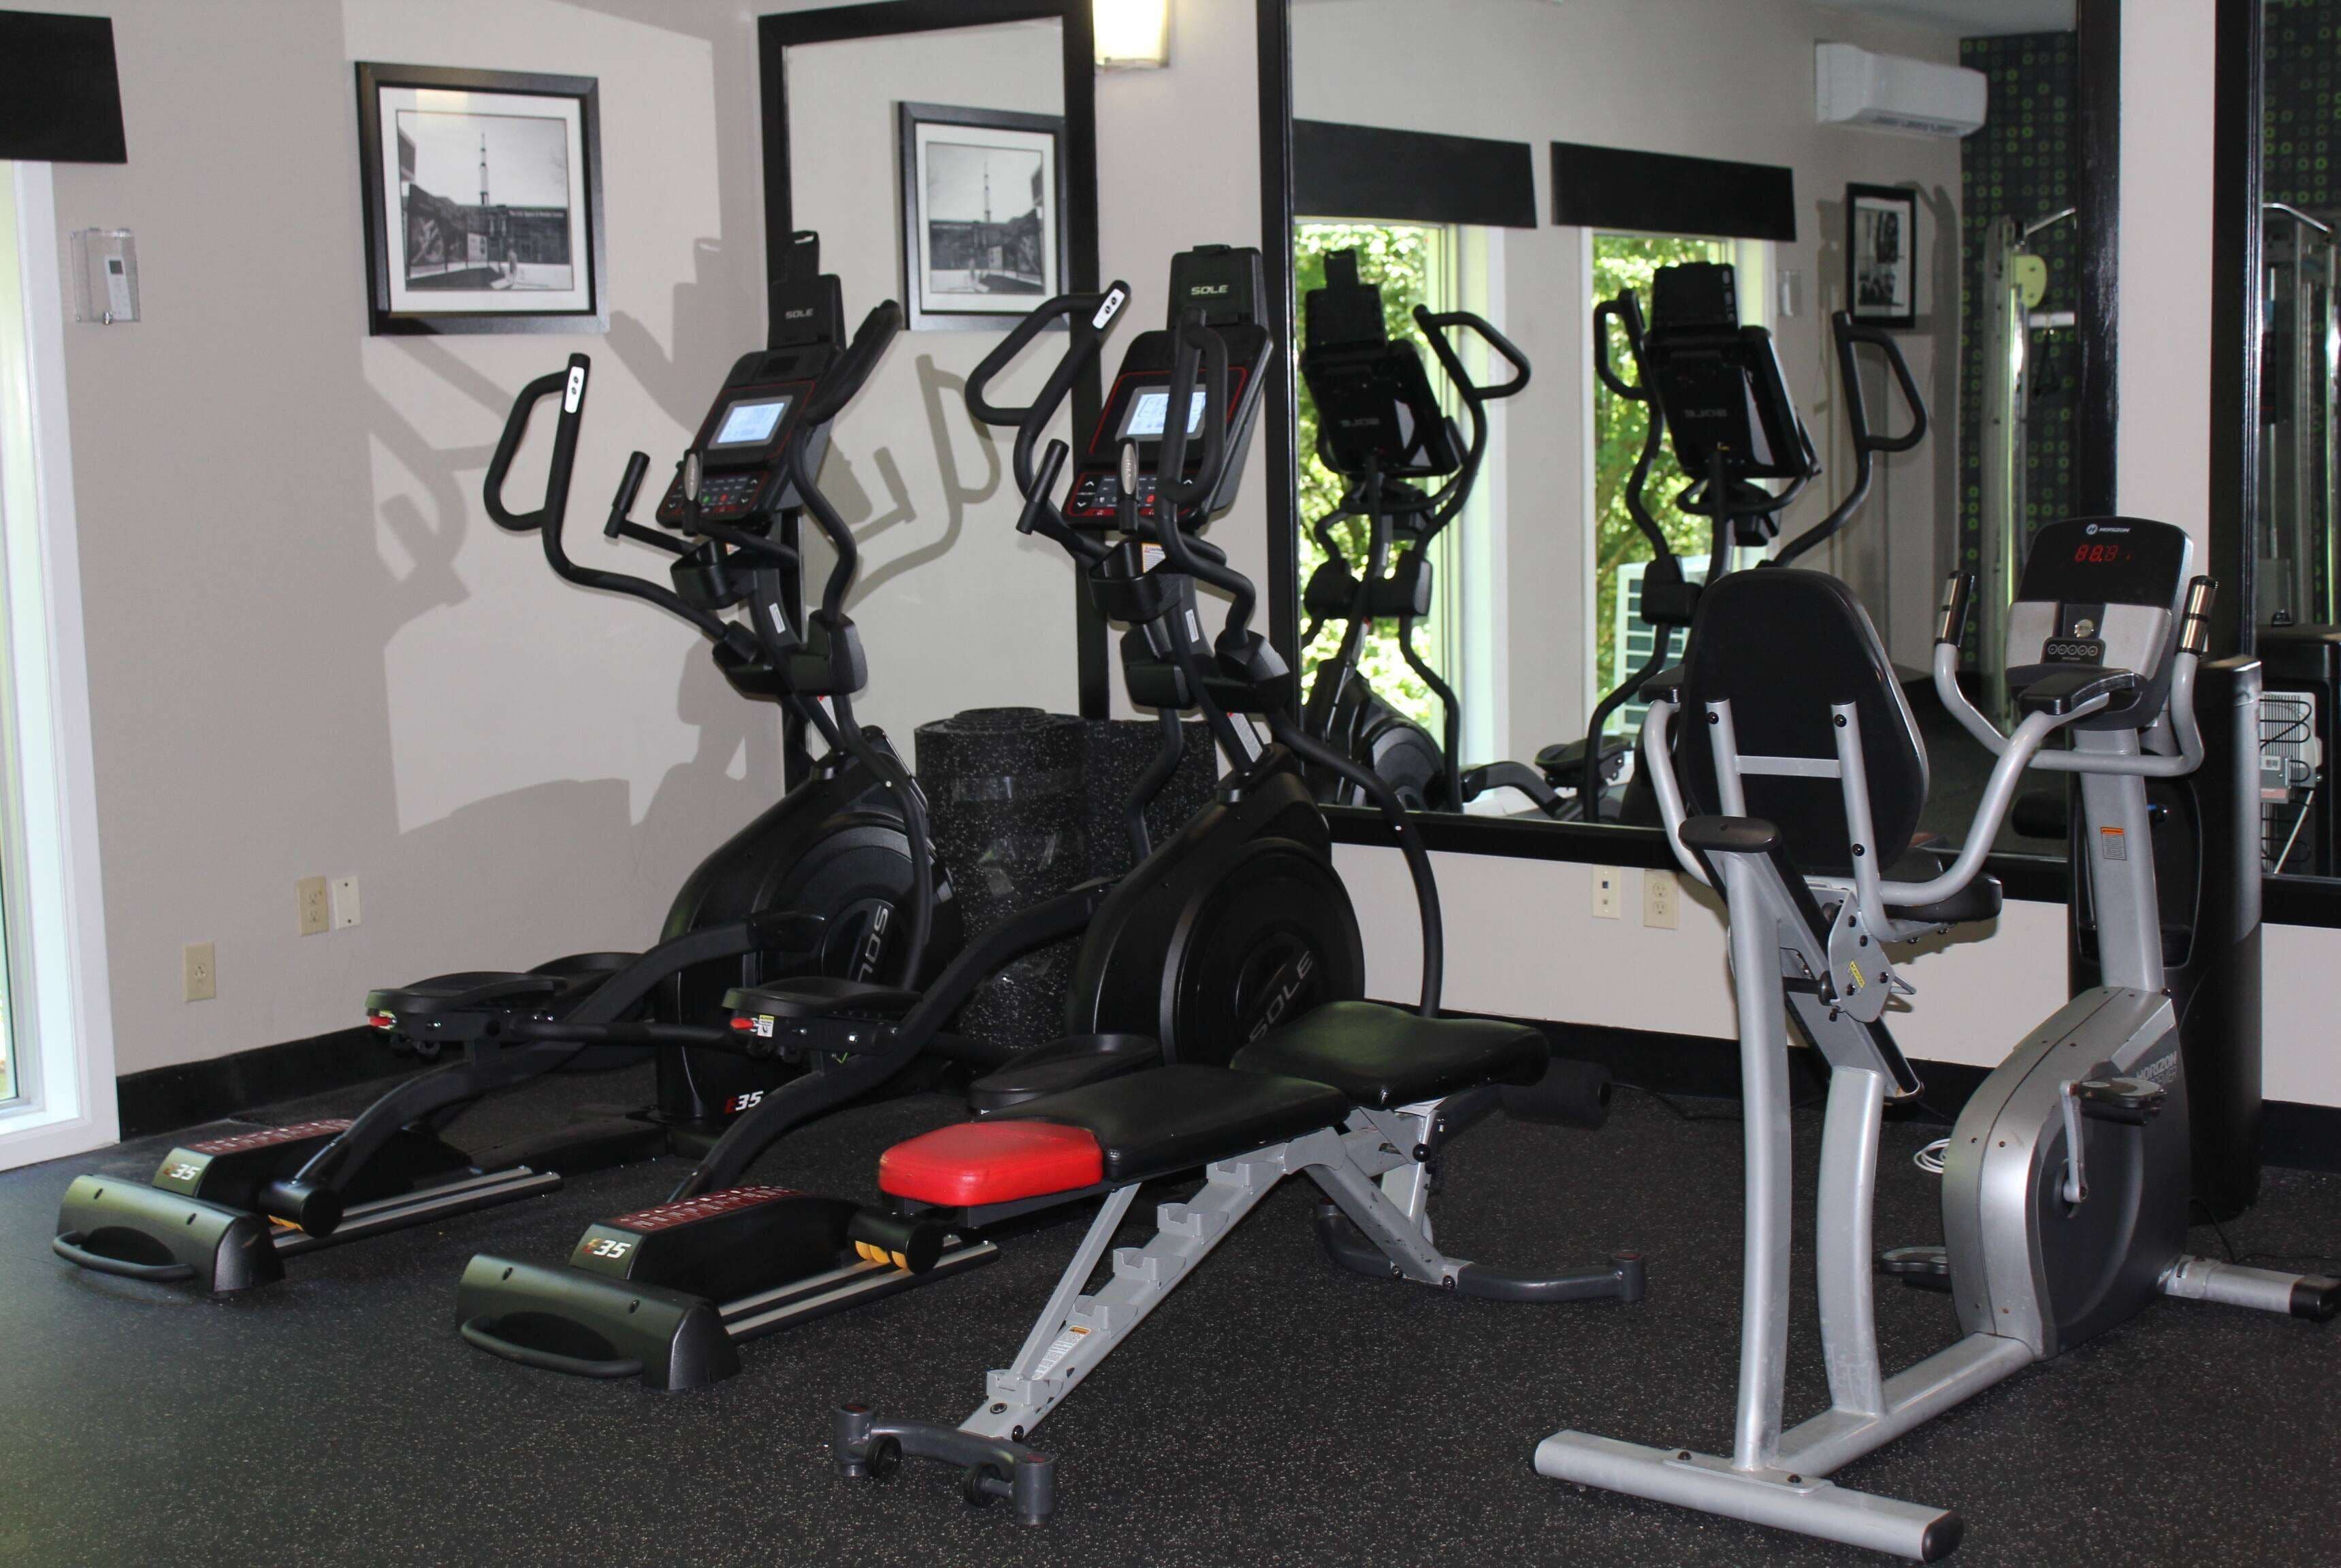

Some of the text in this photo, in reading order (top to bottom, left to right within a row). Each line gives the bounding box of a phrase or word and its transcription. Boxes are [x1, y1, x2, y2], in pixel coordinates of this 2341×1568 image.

[1191, 284, 1229, 295] SOLE
[785, 308, 814, 319] SOLE
[857, 905, 889, 982] SOL
[1248, 950, 1313, 1042] SOLE
[2136, 1050, 2178, 1079] HORIZON
[724, 1090, 764, 1114] E35
[581, 1238, 632, 1258] E35
